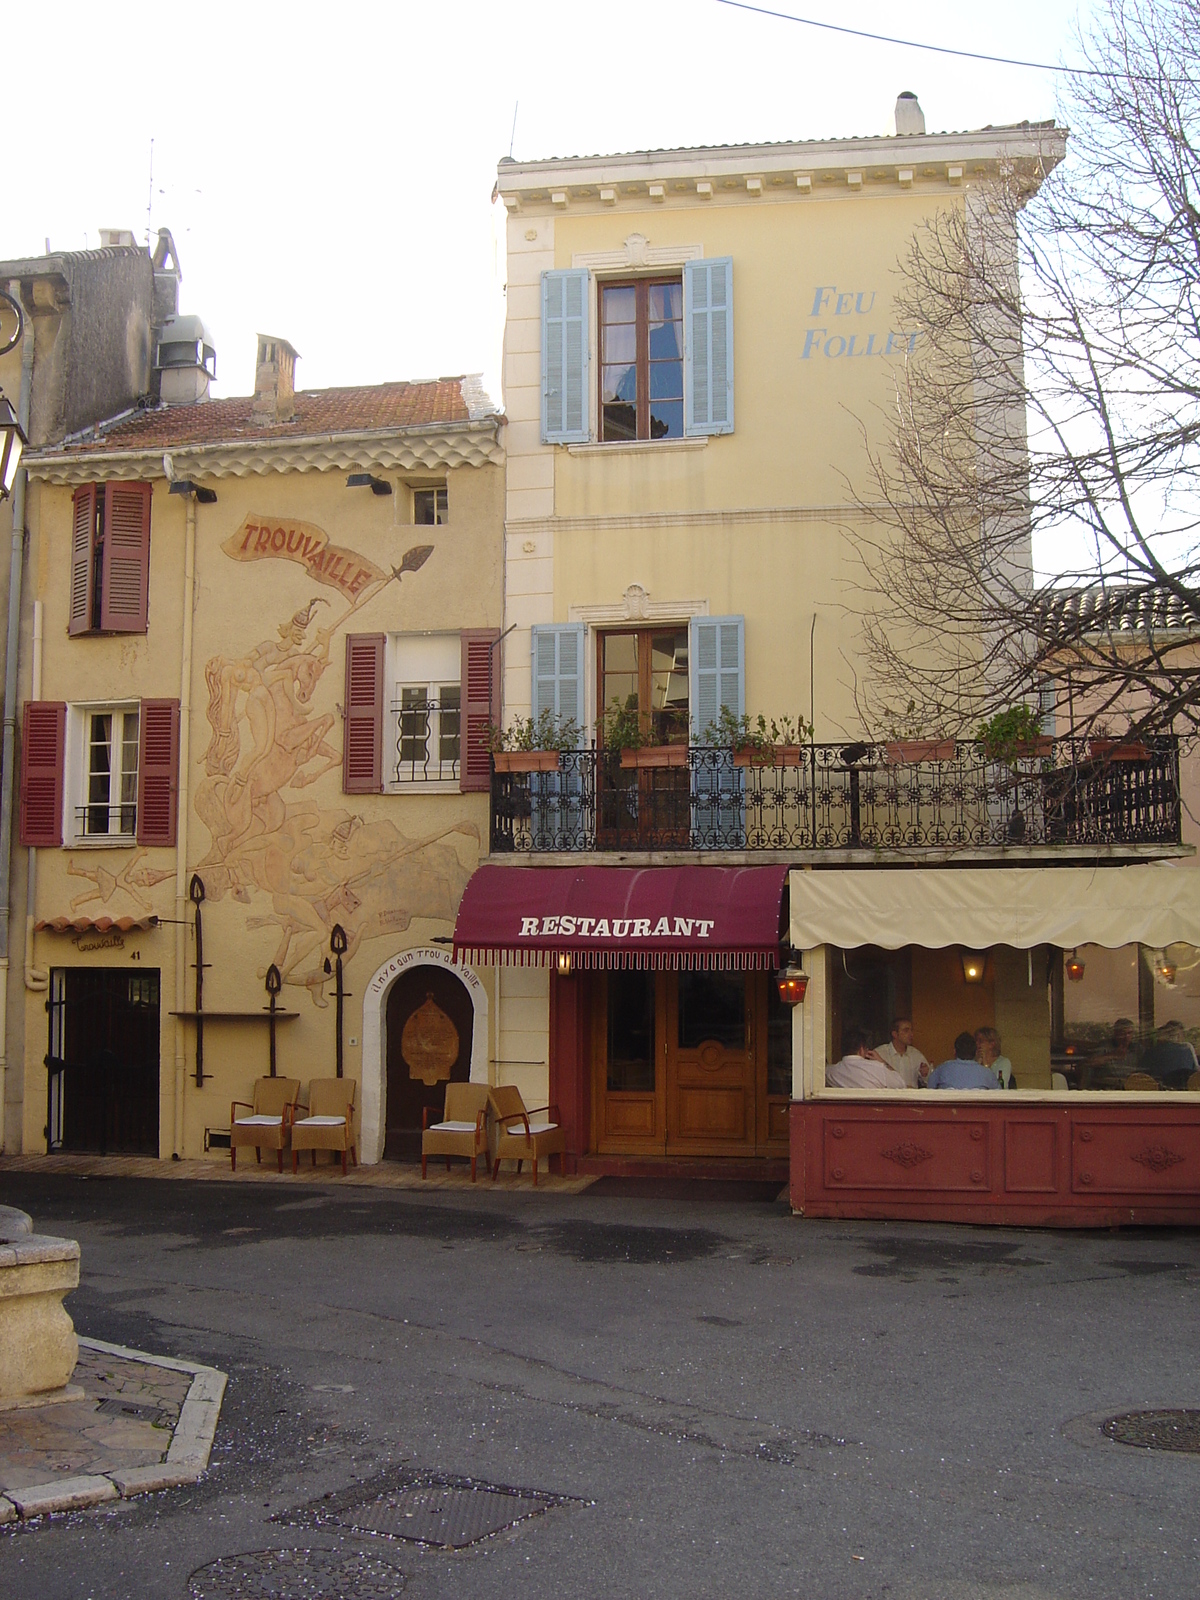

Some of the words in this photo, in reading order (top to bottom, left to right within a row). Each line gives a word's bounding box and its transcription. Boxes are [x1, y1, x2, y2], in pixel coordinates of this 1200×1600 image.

[808, 286, 876, 317] FEU
[799, 328, 923, 359] FOLLET
[240, 523, 373, 595] TROUVAILLE
[518, 915, 715, 938] RESTAURANT
[130, 950, 141, 960] 41
